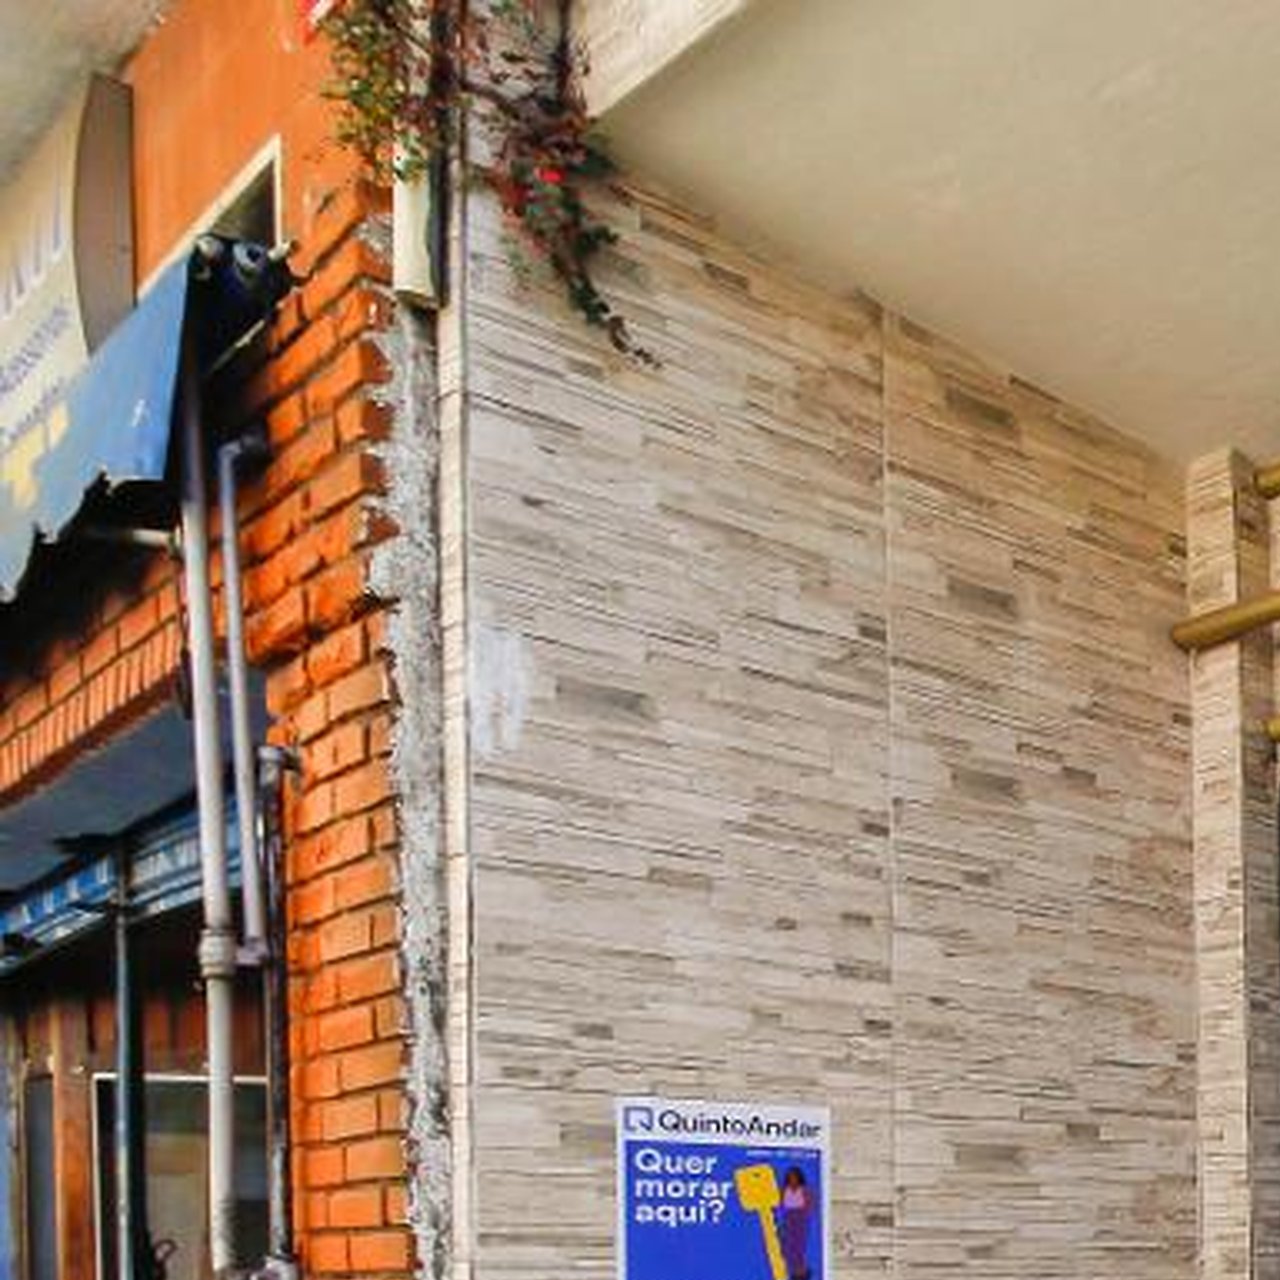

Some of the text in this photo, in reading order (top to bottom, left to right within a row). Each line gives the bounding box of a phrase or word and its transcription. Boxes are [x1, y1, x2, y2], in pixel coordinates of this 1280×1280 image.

[659, 1109, 821, 1138] QuintoAndar
[635, 1148, 718, 1174] Quer
[635, 1178, 733, 1198] morar
[635, 1199, 725, 1227] aqui?
